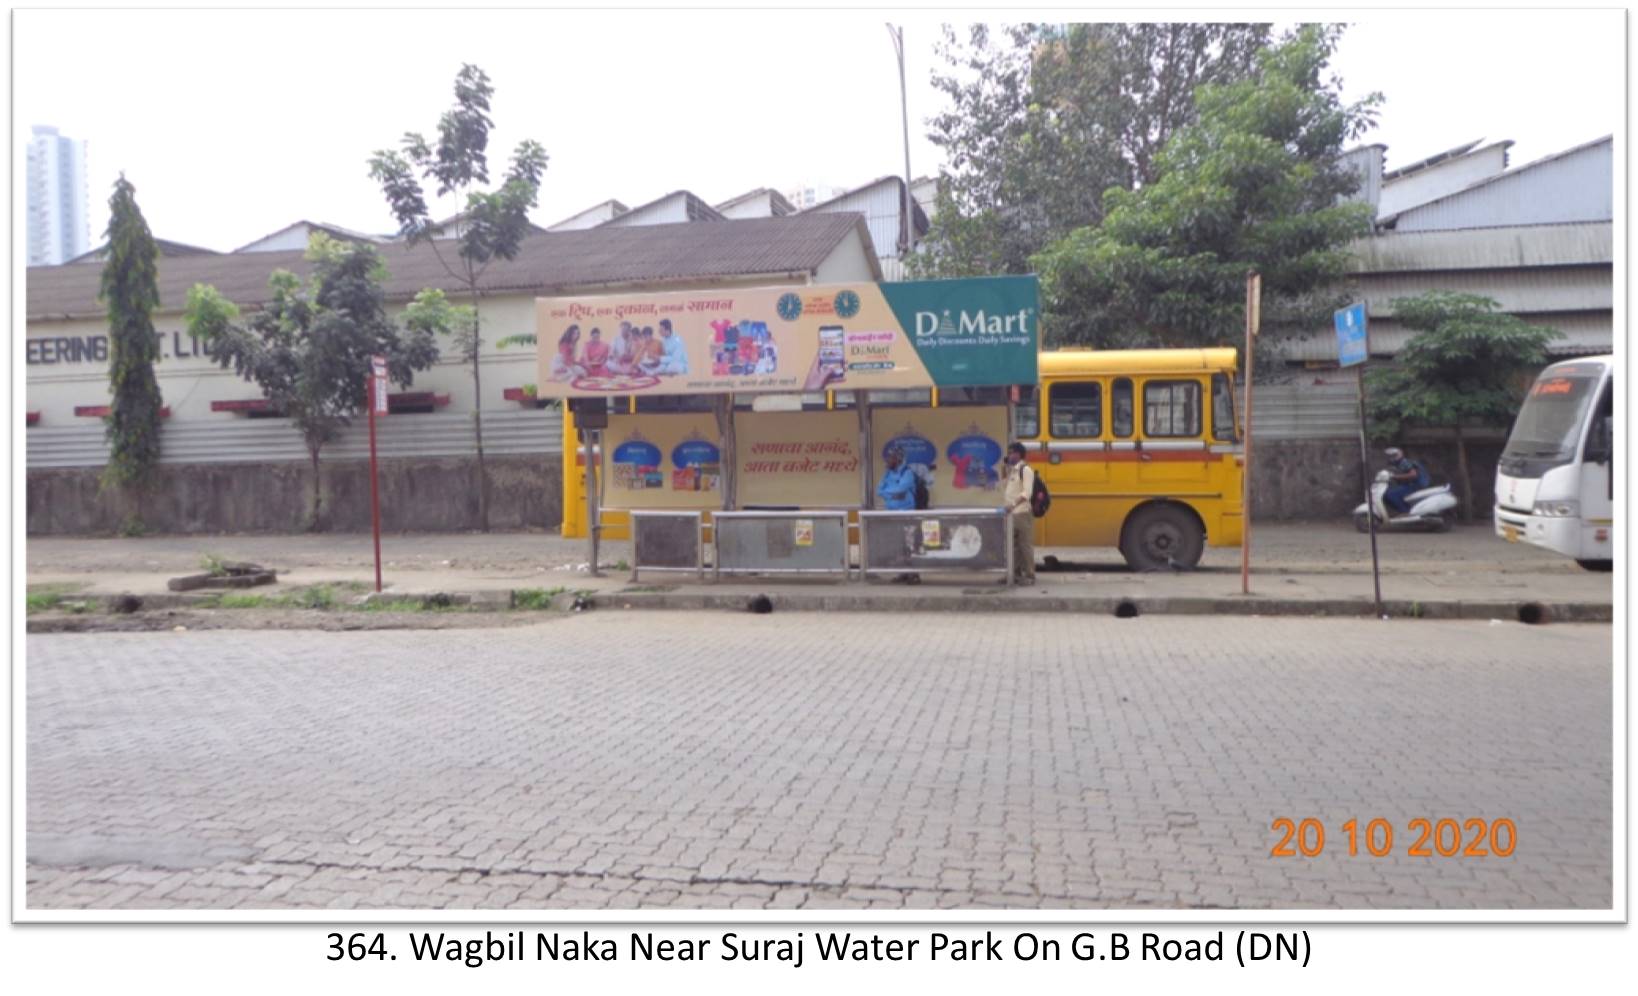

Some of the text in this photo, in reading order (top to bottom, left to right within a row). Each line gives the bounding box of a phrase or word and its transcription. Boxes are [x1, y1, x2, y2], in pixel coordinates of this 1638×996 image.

[687, 300, 734, 312] सामान
[917, 335, 1031, 349] Daily Discounts Daily Savings
[751, 437, 853, 455] सणाचा आनंद,
[744, 456, 858, 473] आता बजेट मध्ये
